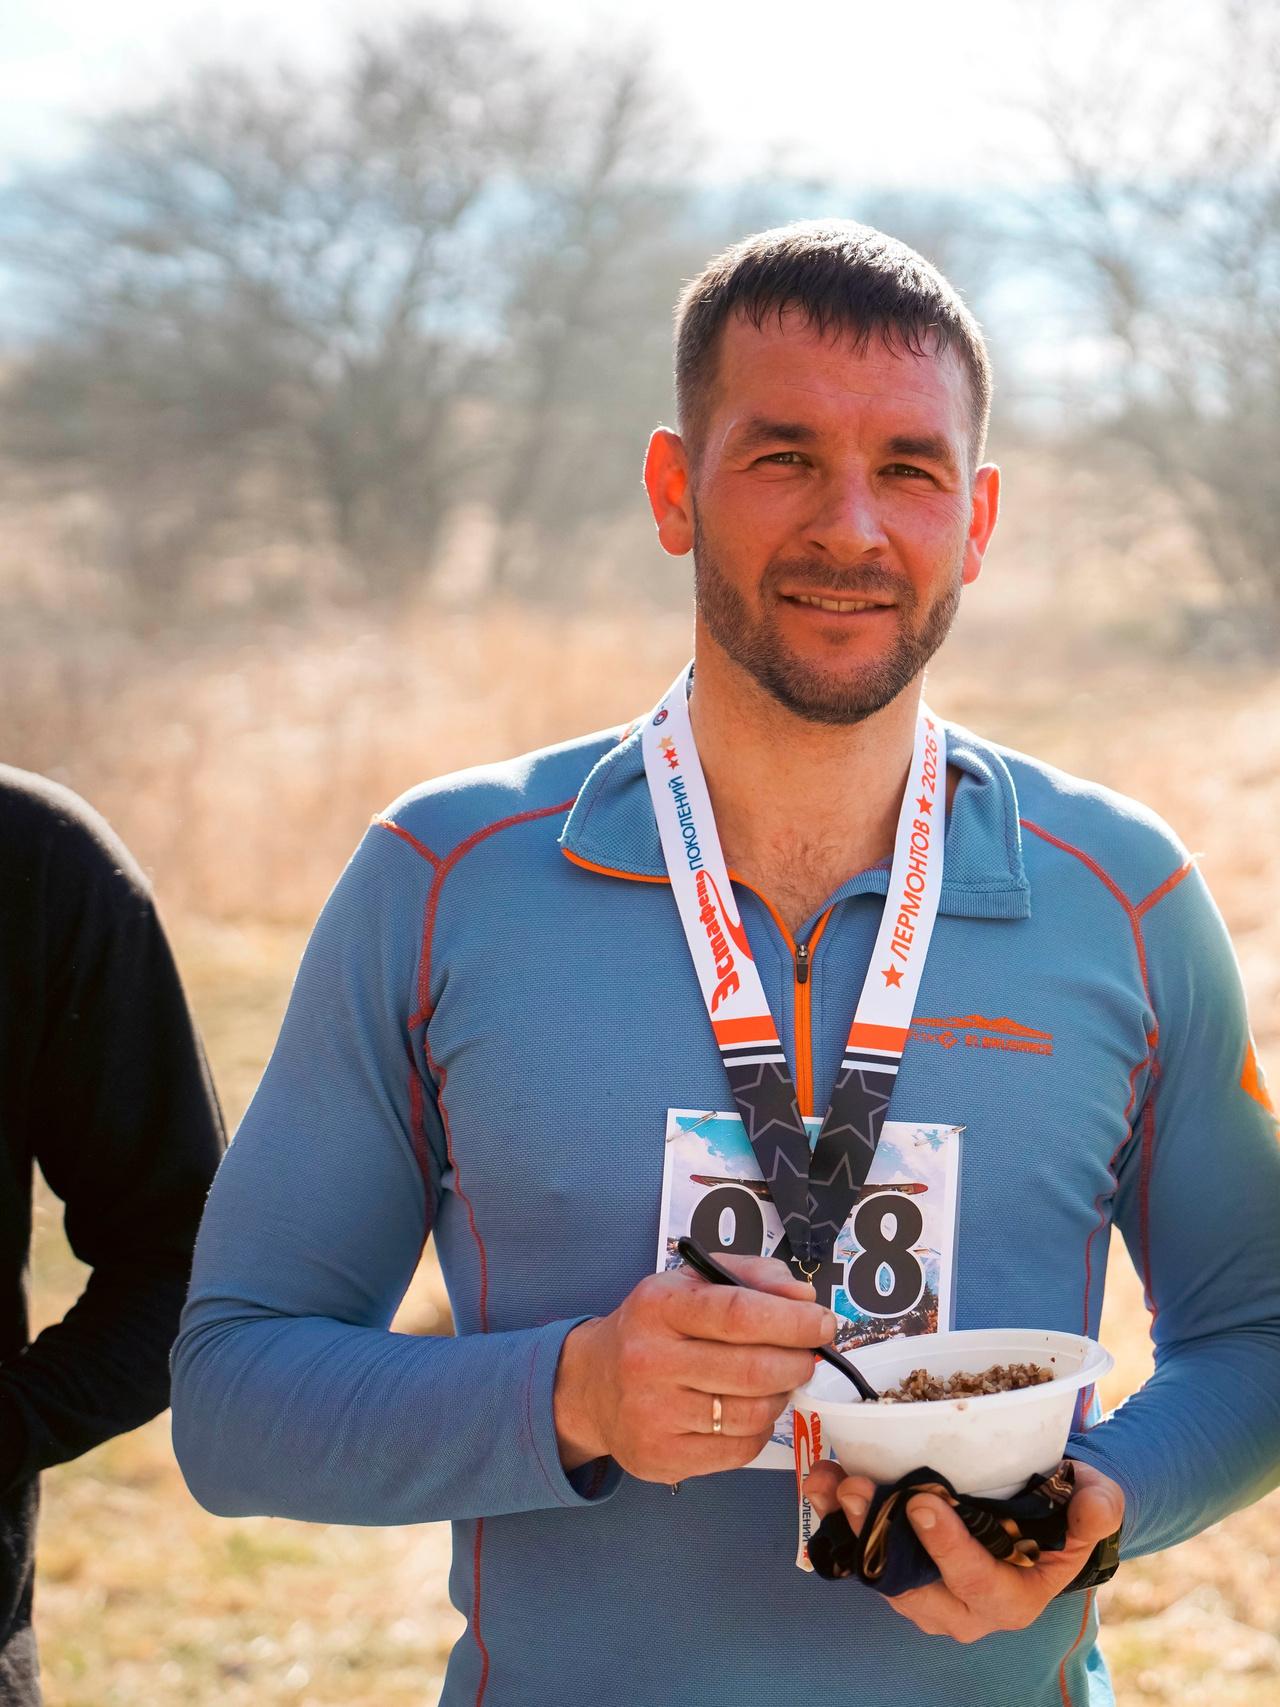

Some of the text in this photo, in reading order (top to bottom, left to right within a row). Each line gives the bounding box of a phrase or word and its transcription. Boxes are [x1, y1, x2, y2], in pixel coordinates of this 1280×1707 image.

[668, 775, 740, 1014] Эстафета ПОКОЛЕНИЙ
[890, 734, 938, 962] ЛЕРМОНТОВ 2026
